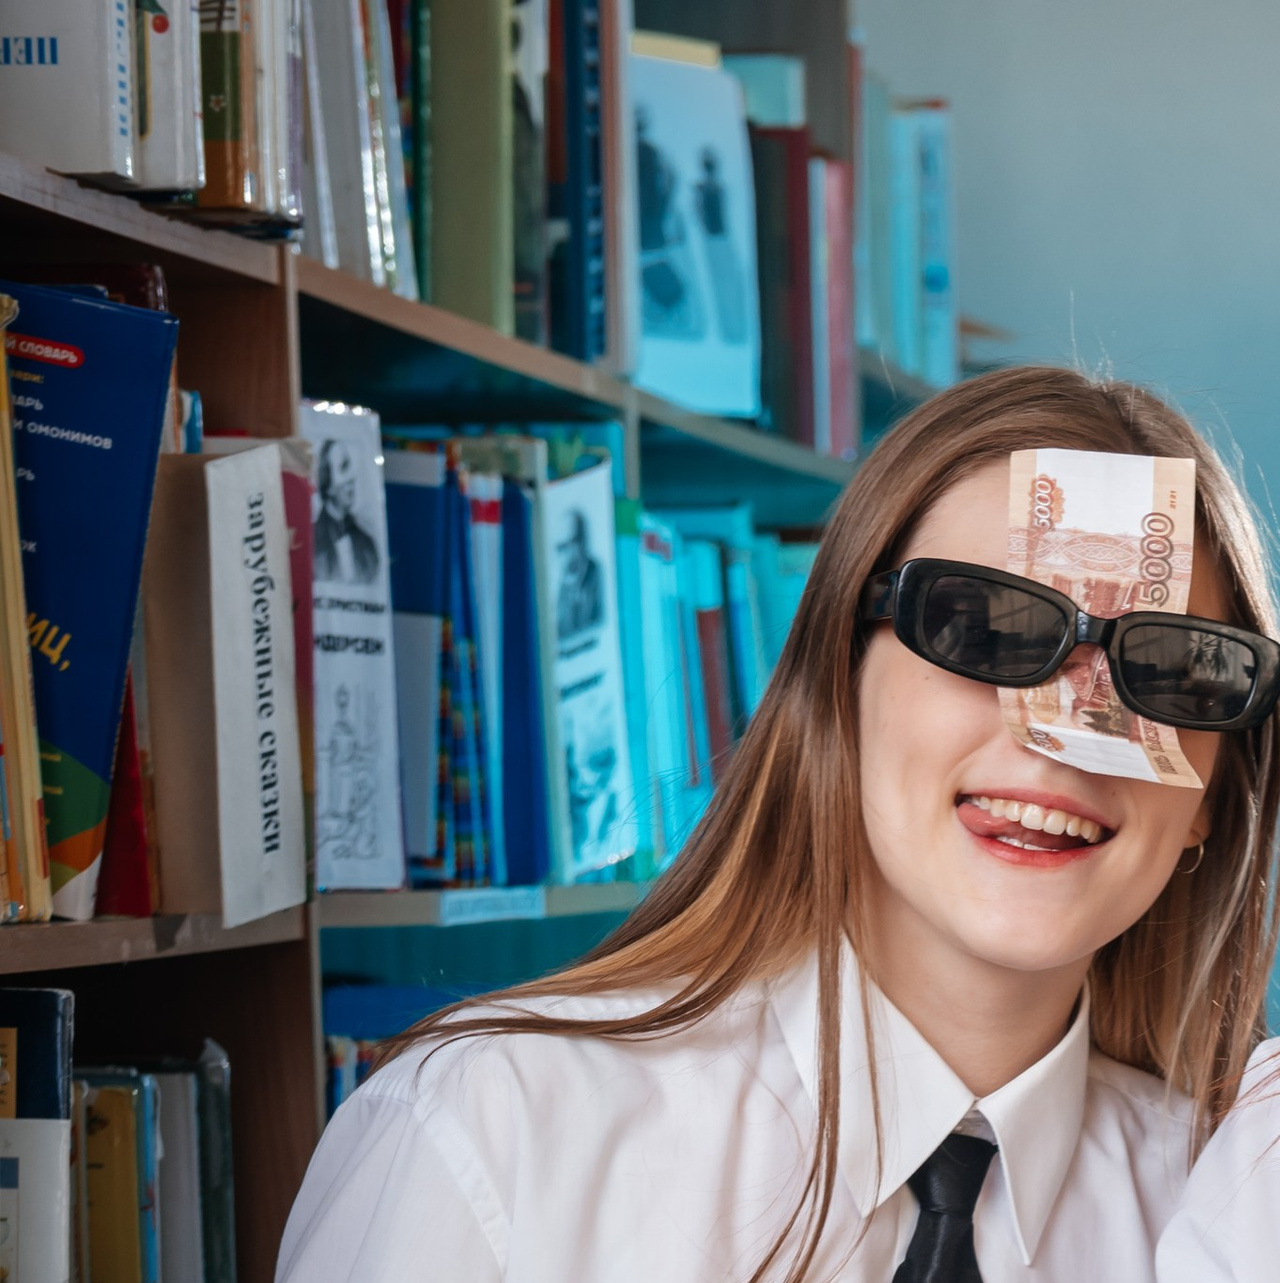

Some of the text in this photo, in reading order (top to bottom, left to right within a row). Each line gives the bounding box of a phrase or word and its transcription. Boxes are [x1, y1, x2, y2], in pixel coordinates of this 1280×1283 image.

[19, 340, 78, 364] СЛОВАРЬ
[27, 420, 113, 450] ОМОНИМОВ
[1031, 479, 1053, 530] 5000
[1137, 511, 1176, 608] 5000
[242, 491, 282, 855] зарубежные сказки
